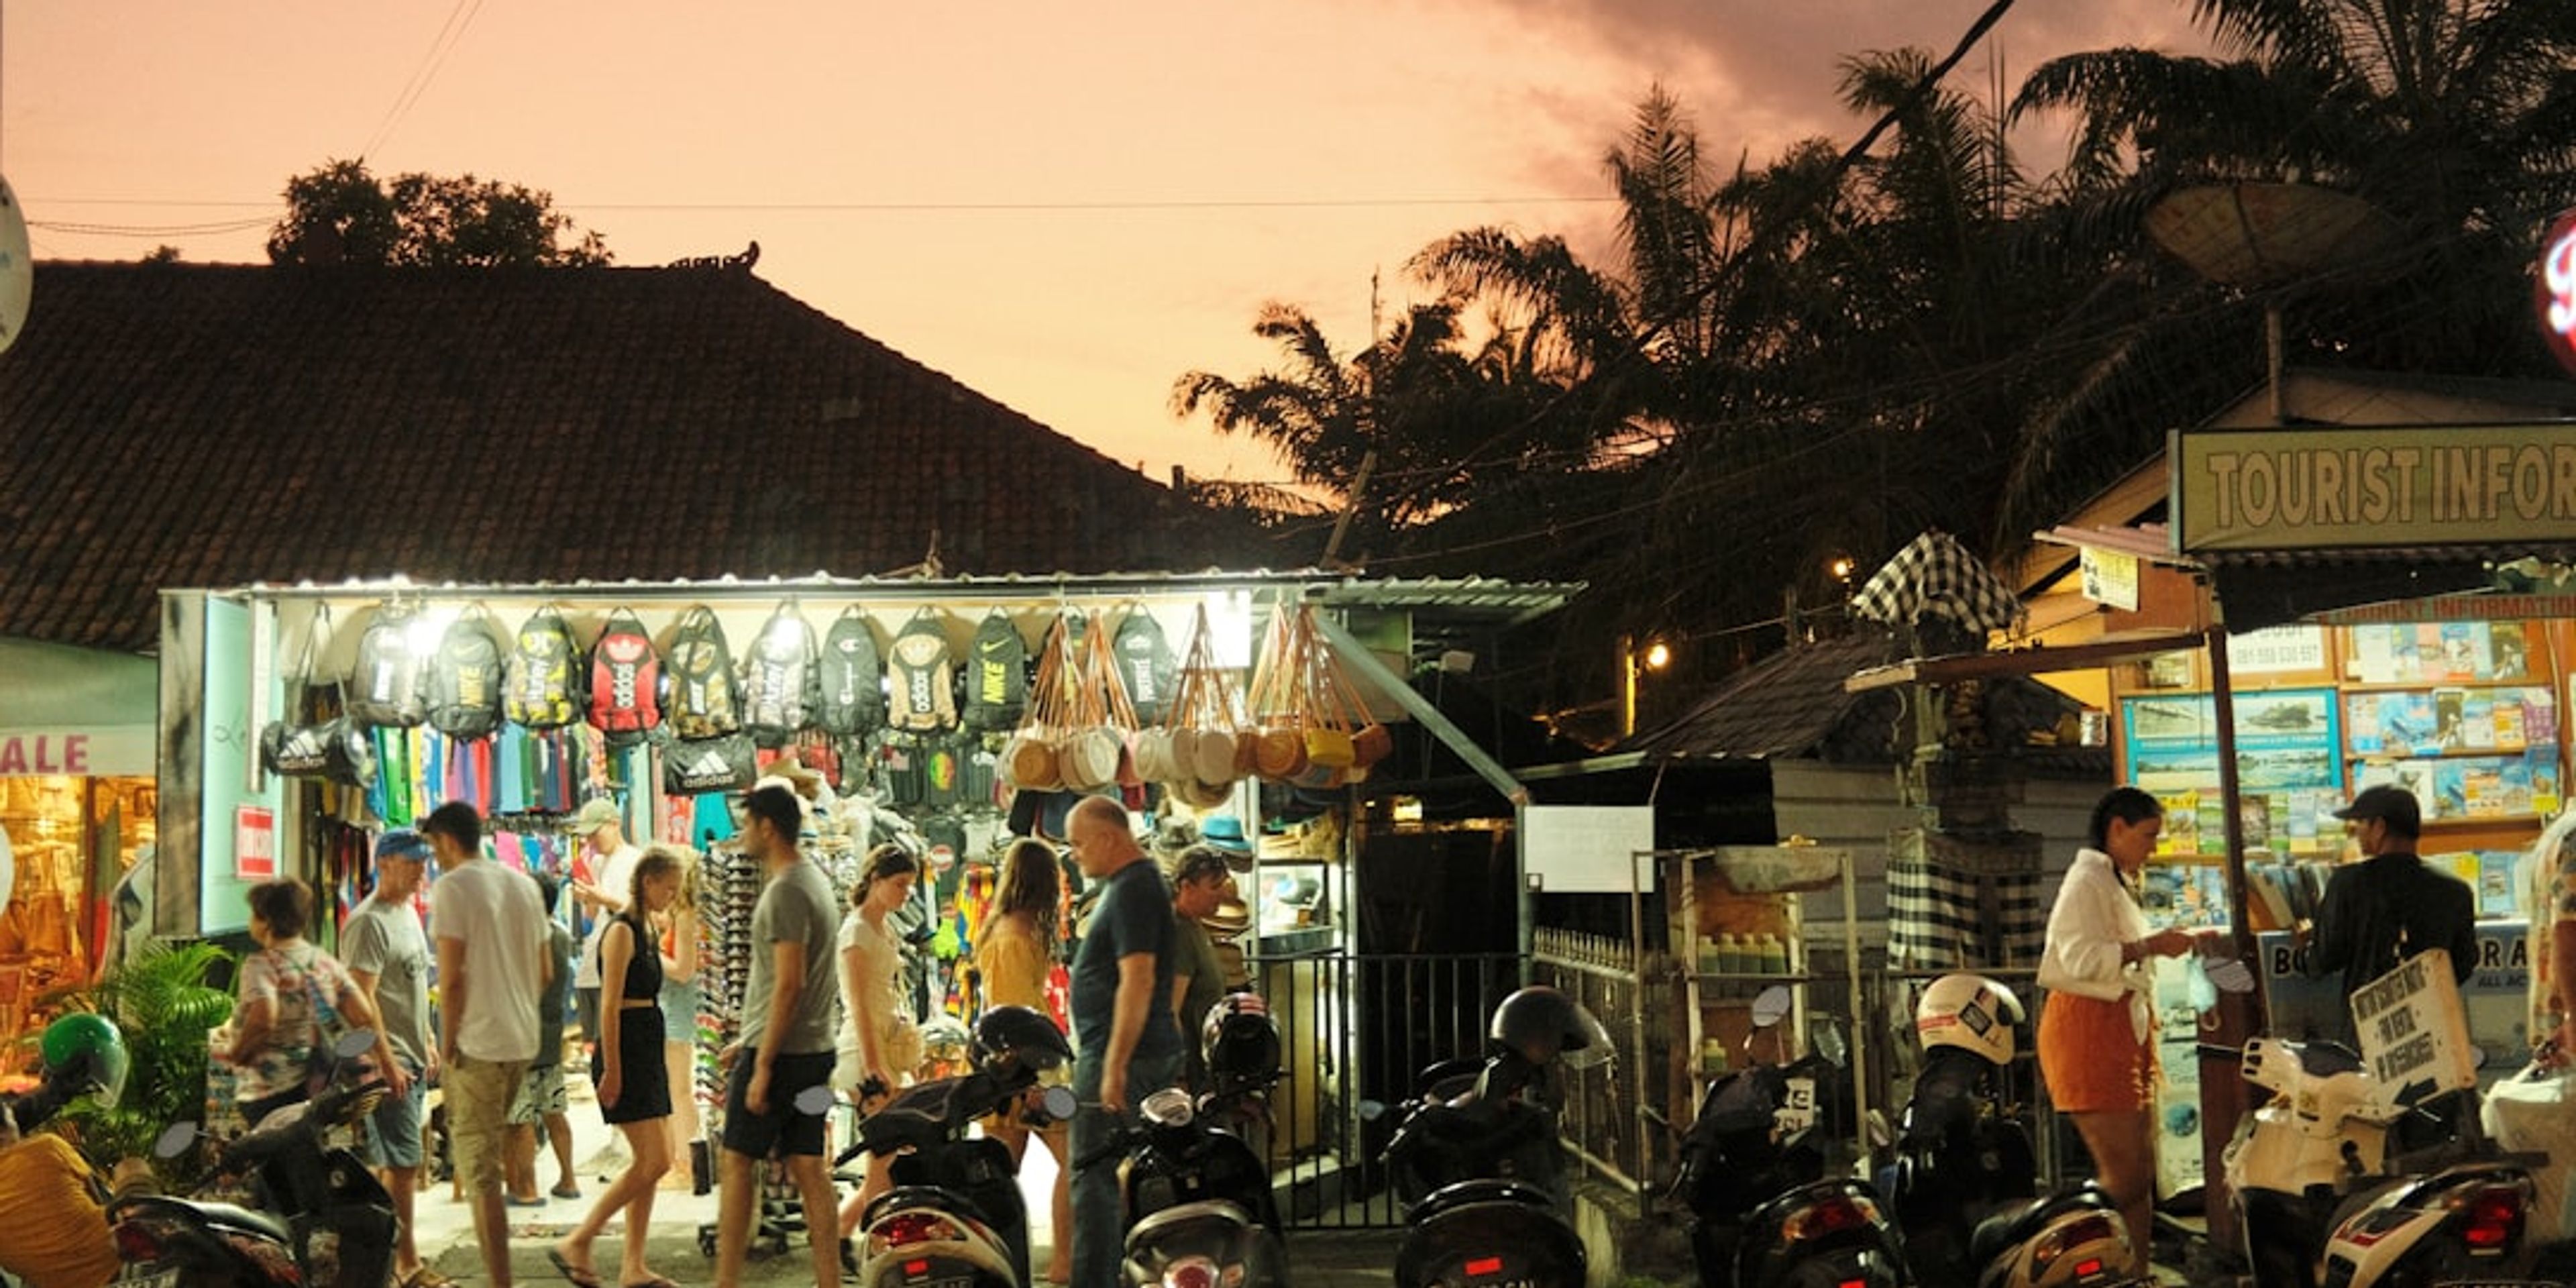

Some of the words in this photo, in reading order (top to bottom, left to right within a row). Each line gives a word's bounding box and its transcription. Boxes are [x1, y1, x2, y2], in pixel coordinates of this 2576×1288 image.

[2206, 446, 2421, 529] TOURIST
[2430, 443, 2576, 523] INFOR
[612, 662, 636, 708] adidas
[981, 659, 1006, 704] NIKE
[0, 735, 89, 773] ALE
[684, 774, 735, 788] adidas
